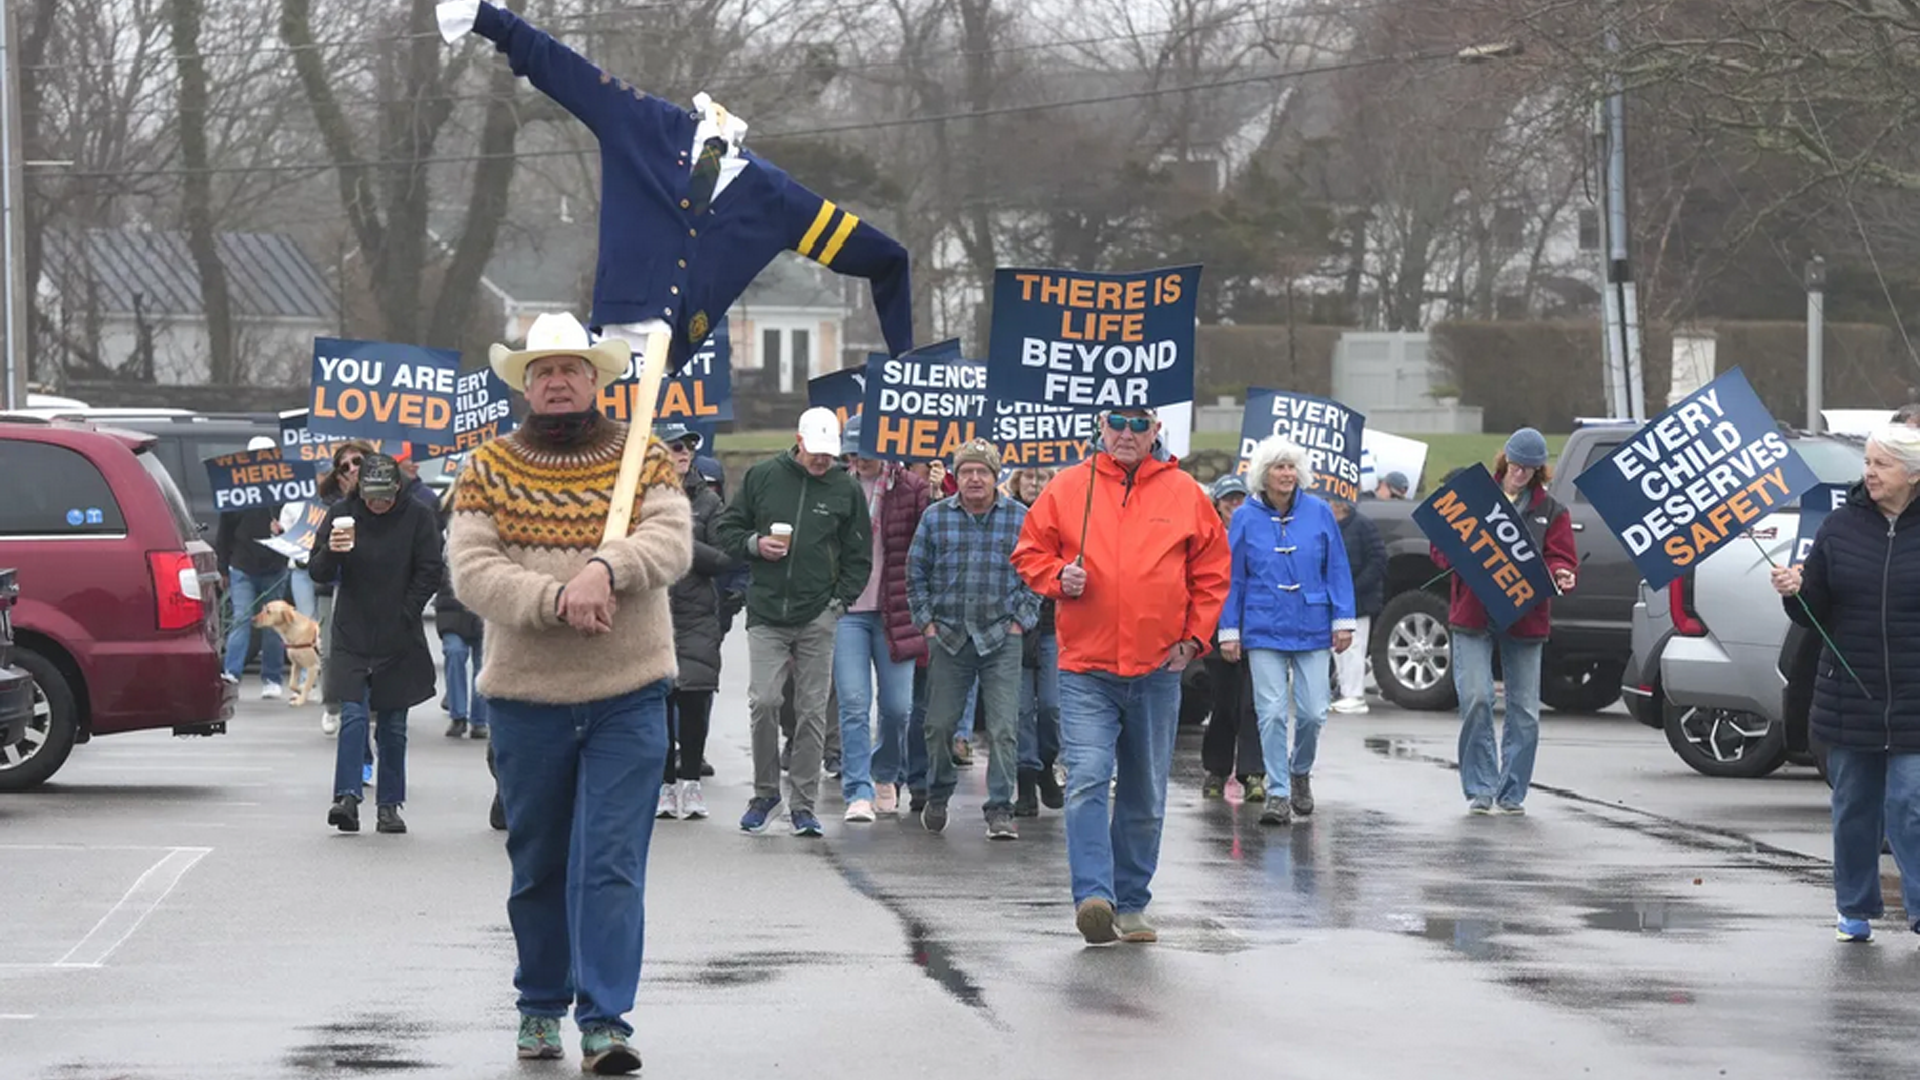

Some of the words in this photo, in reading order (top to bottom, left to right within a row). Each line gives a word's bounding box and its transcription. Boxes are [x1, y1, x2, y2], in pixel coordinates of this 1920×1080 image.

[1015, 274, 1147, 310] THERE
[1153, 274, 1183, 306] IS
[1060, 311, 1145, 343] LIFE
[318, 356, 383, 386] YOU
[391, 364, 455, 393] ARE
[1021, 337, 1178, 375] BEYOND
[882, 360, 988, 390] SILENCE
[1044, 373, 1149, 407] FEAR
[313, 386, 451, 431] LOVED
[596, 380, 719, 420] HAL
[879, 388, 988, 417] DOESN'T
[1272, 395, 1350, 433] EVERY
[994, 440, 1091, 465] AFETY
[1273, 418, 1346, 454] CHILD
[1612, 388, 1725, 481] EVERY
[215, 452, 251, 467] WE
[231, 463, 295, 485] HERE
[1240, 438, 1359, 484] DRVES
[1640, 420, 1742, 501] CHILD
[216, 486, 262, 508] FOR
[268, 479, 317, 502] YOU
[1621, 431, 1789, 556] DESERVES
[1484, 502, 1535, 562] YOU
[1664, 466, 1791, 567] SAFETY
[1432, 490, 1535, 608] MATTER
